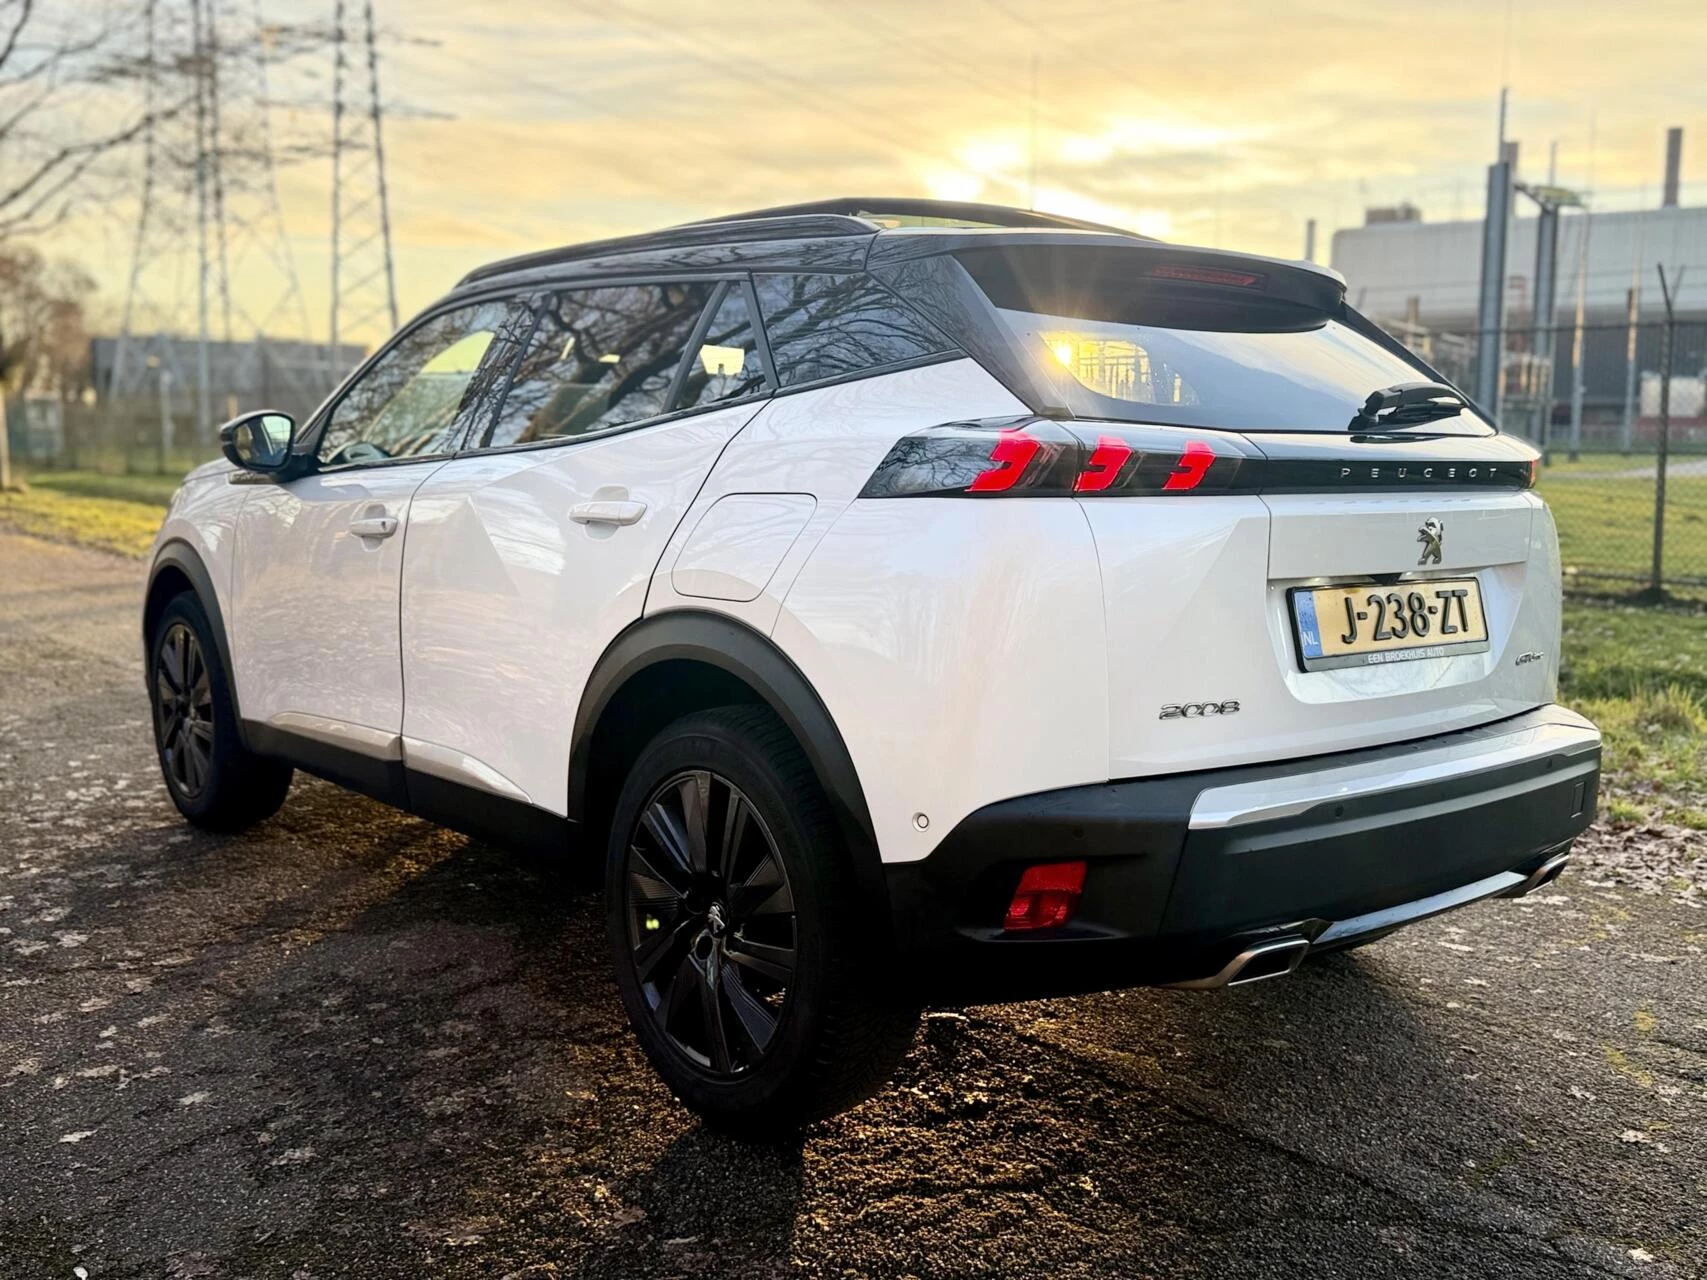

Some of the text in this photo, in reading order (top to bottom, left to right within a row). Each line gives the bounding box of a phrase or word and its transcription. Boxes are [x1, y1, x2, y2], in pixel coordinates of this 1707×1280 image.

[1340, 467, 1497, 479] PEUGEOT
[1342, 590, 1468, 644] J-238-ZT
[1303, 631, 1319, 646] NL
[1427, 646, 1445, 658] AUTO
[1159, 700, 1241, 720] 2008
